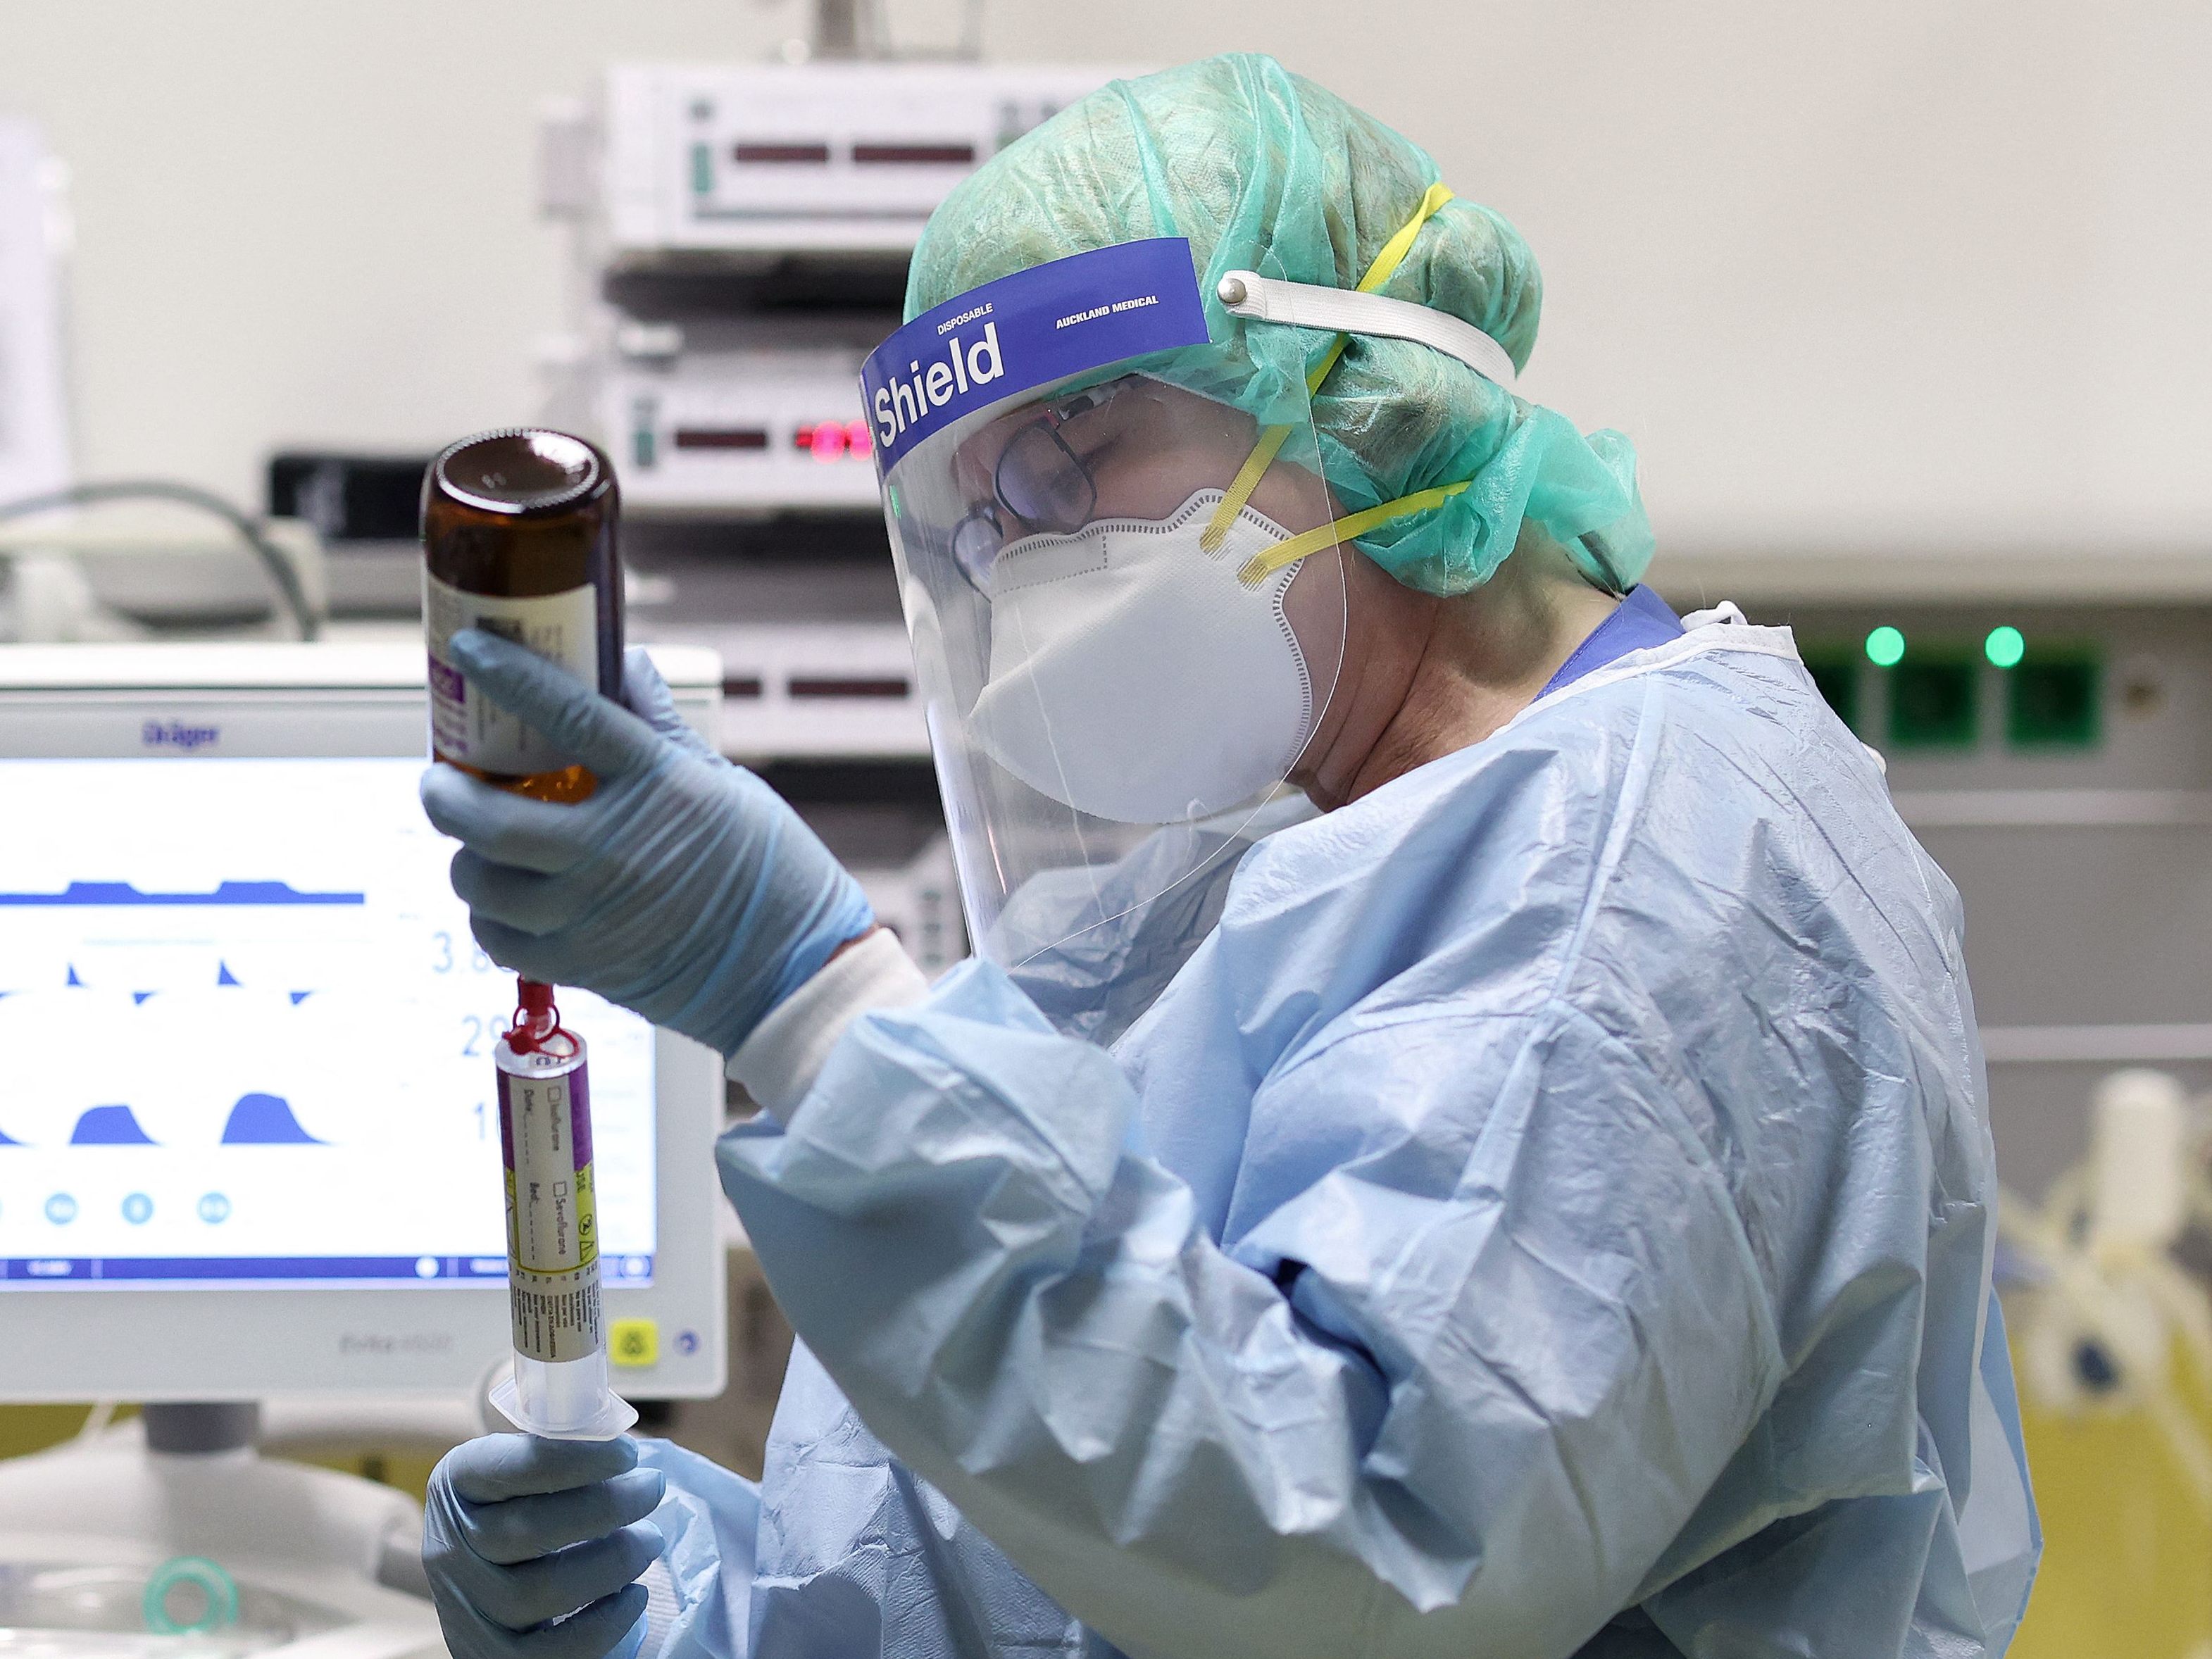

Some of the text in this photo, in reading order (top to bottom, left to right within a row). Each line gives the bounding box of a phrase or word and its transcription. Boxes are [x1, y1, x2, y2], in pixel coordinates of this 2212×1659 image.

[937, 302, 994, 336] DISPOSABLE
[1056, 294, 1159, 330] AUCKLAND MEDICAL
[874, 321, 1006, 449] Shield
